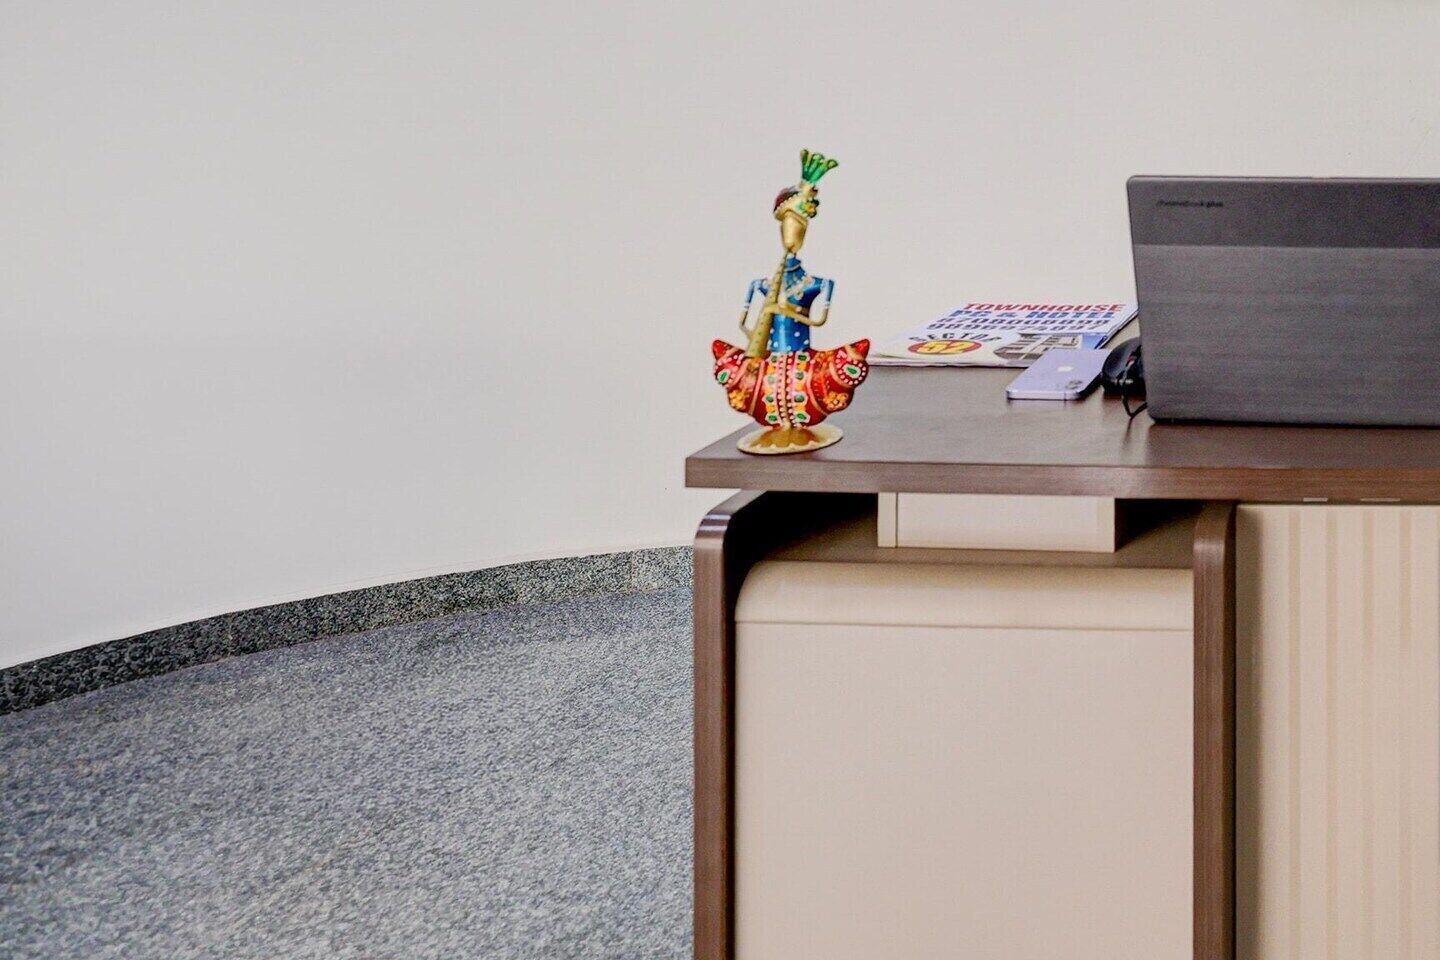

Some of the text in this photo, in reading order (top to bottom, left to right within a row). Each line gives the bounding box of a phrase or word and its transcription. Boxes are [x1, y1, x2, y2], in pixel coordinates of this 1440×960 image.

[963, 303, 1125, 311] TOWNHOUSE
[909, 333, 1003, 342] SECTOR
[916, 341, 976, 354] 52
